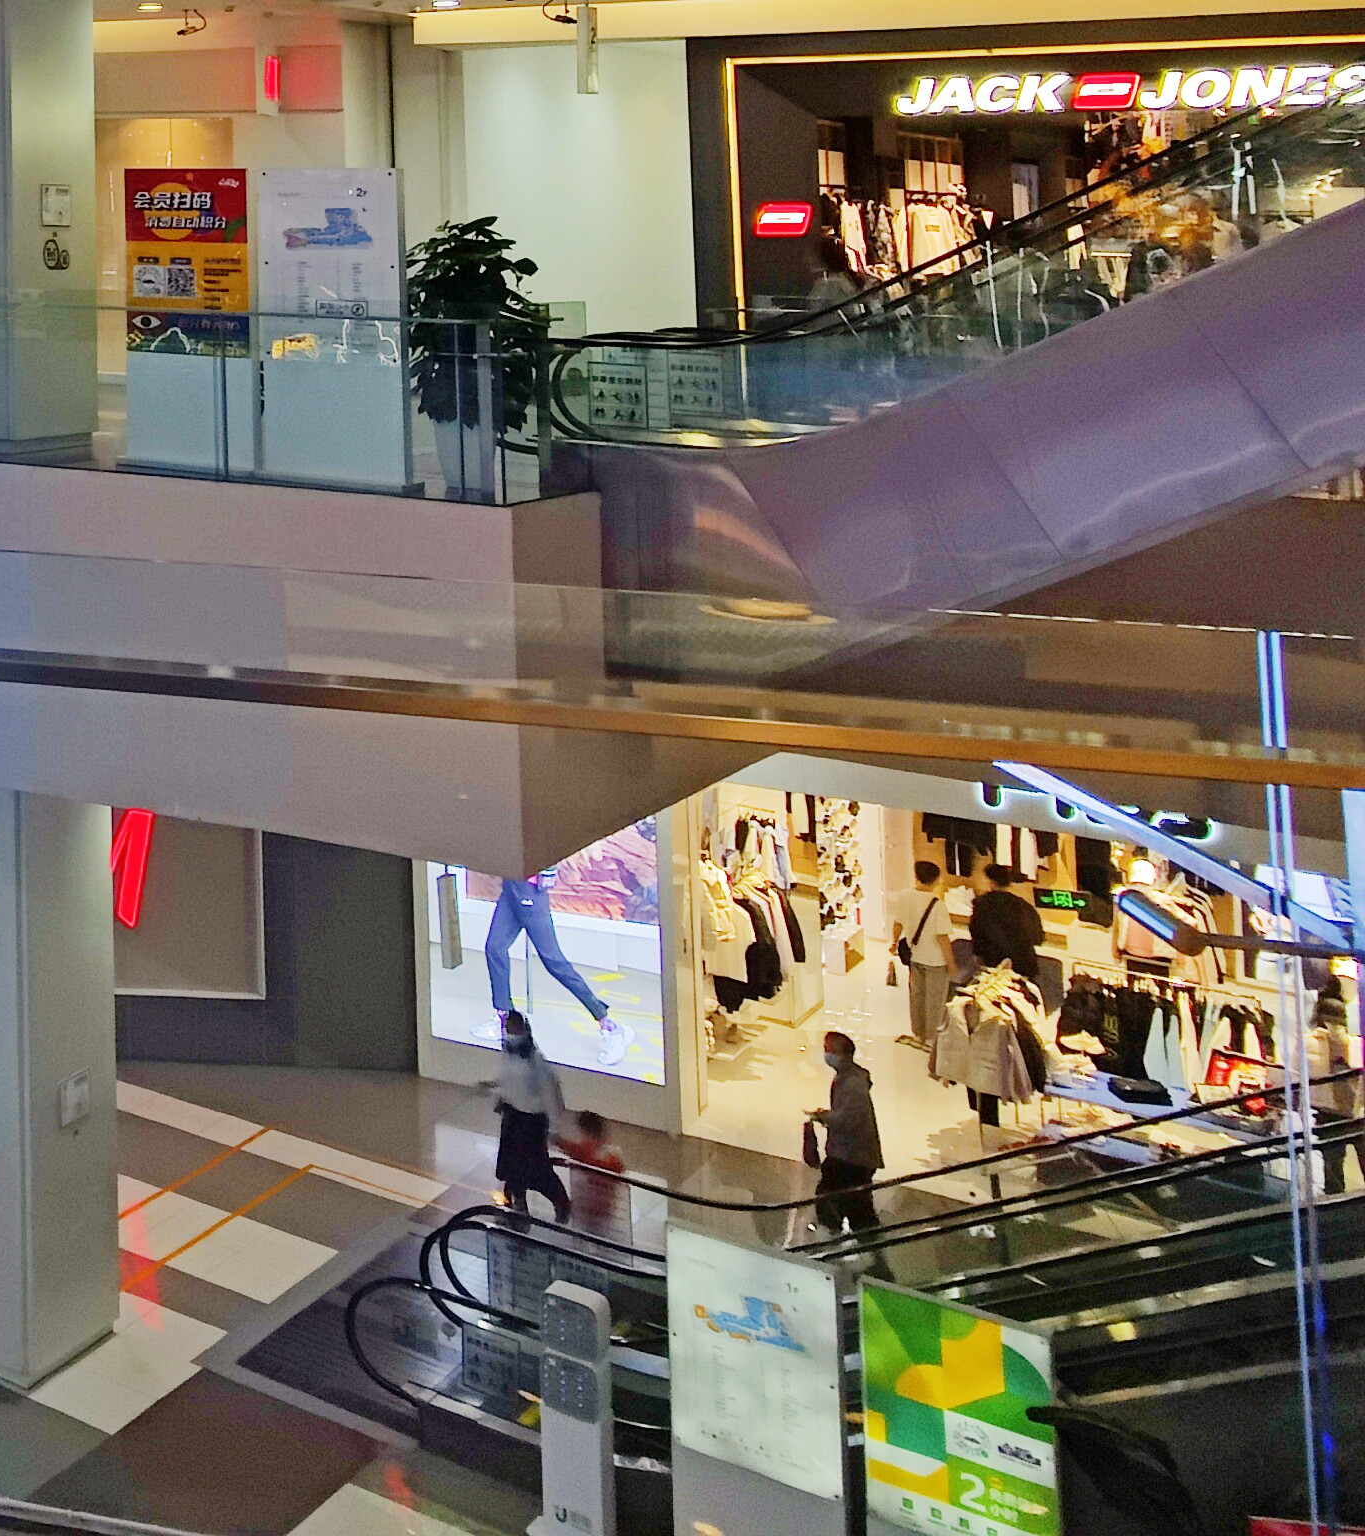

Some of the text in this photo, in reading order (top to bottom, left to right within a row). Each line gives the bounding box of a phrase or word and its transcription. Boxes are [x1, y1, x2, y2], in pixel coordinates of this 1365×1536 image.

[895, 72, 1070, 117] JACK
[133, 190, 213, 210] 会员扫码
